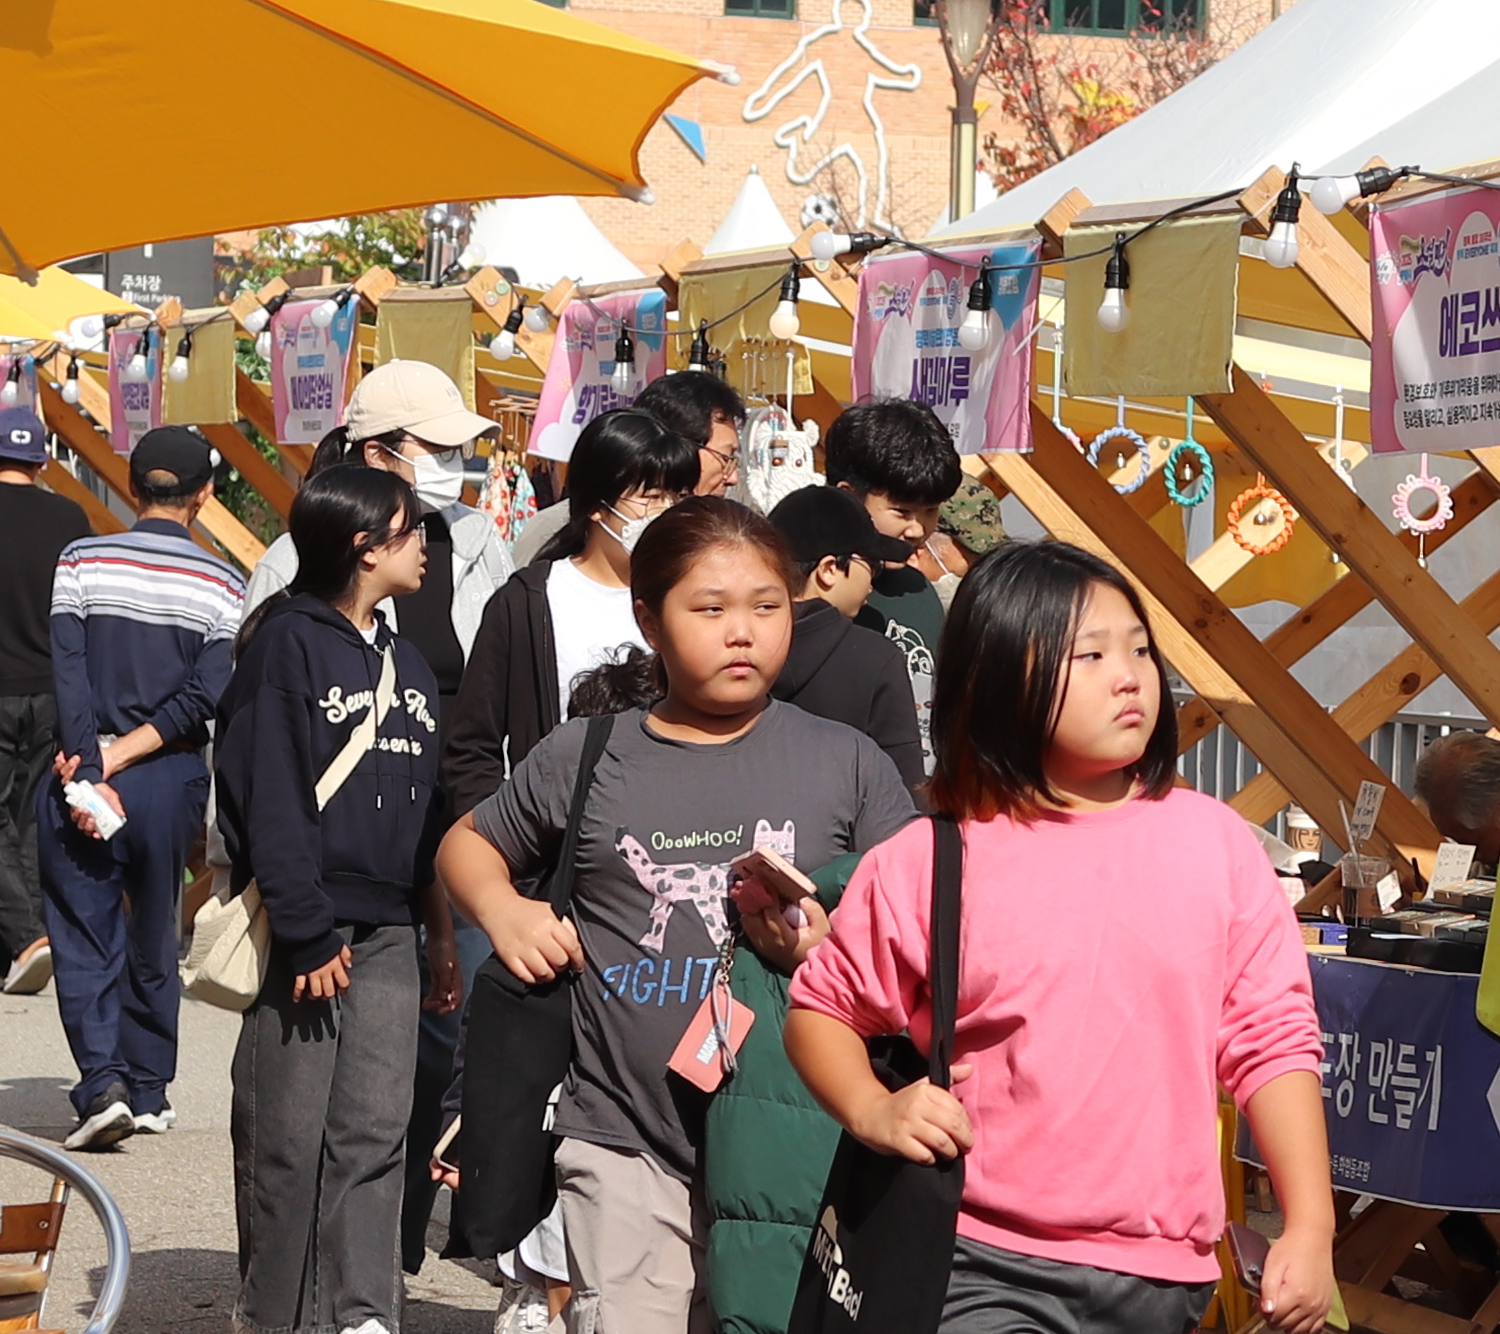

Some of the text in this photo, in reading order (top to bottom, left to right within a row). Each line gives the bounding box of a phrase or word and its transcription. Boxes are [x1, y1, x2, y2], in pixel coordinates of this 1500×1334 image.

[120, 273, 162, 292] 주차장
[403, 688, 436, 733] Ave
[602, 956, 719, 1007] FIGHT
[1368, 1038, 1443, 1131] 만들기
